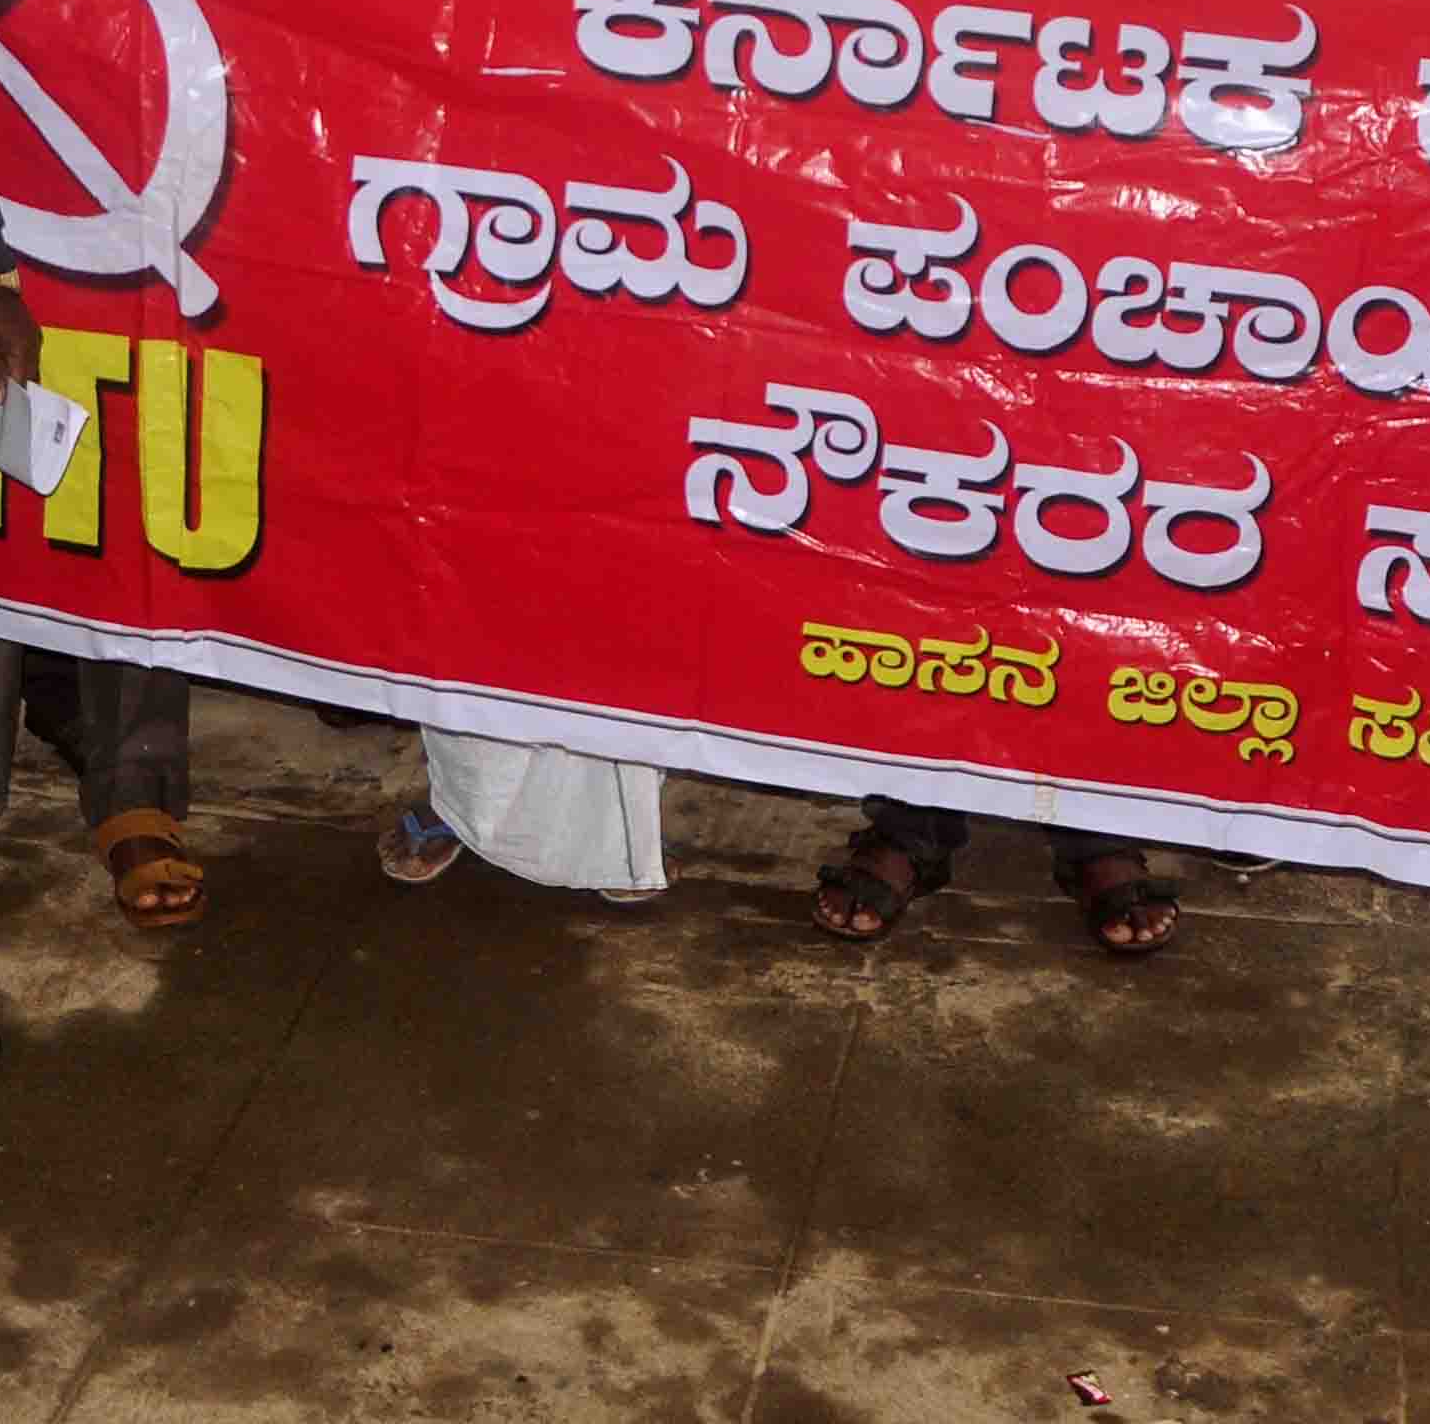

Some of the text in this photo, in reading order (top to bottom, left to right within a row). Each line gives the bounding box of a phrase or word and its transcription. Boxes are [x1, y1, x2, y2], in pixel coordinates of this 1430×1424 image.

[348, 154, 749, 328] ಗ್ರಾಮ
[684, 381, 1272, 587] ನೌಕರರ
[800, 620, 1060, 706] ಹಾಸನ
[1106, 664, 1298, 763] ಜಿಲ್ಲಾ
